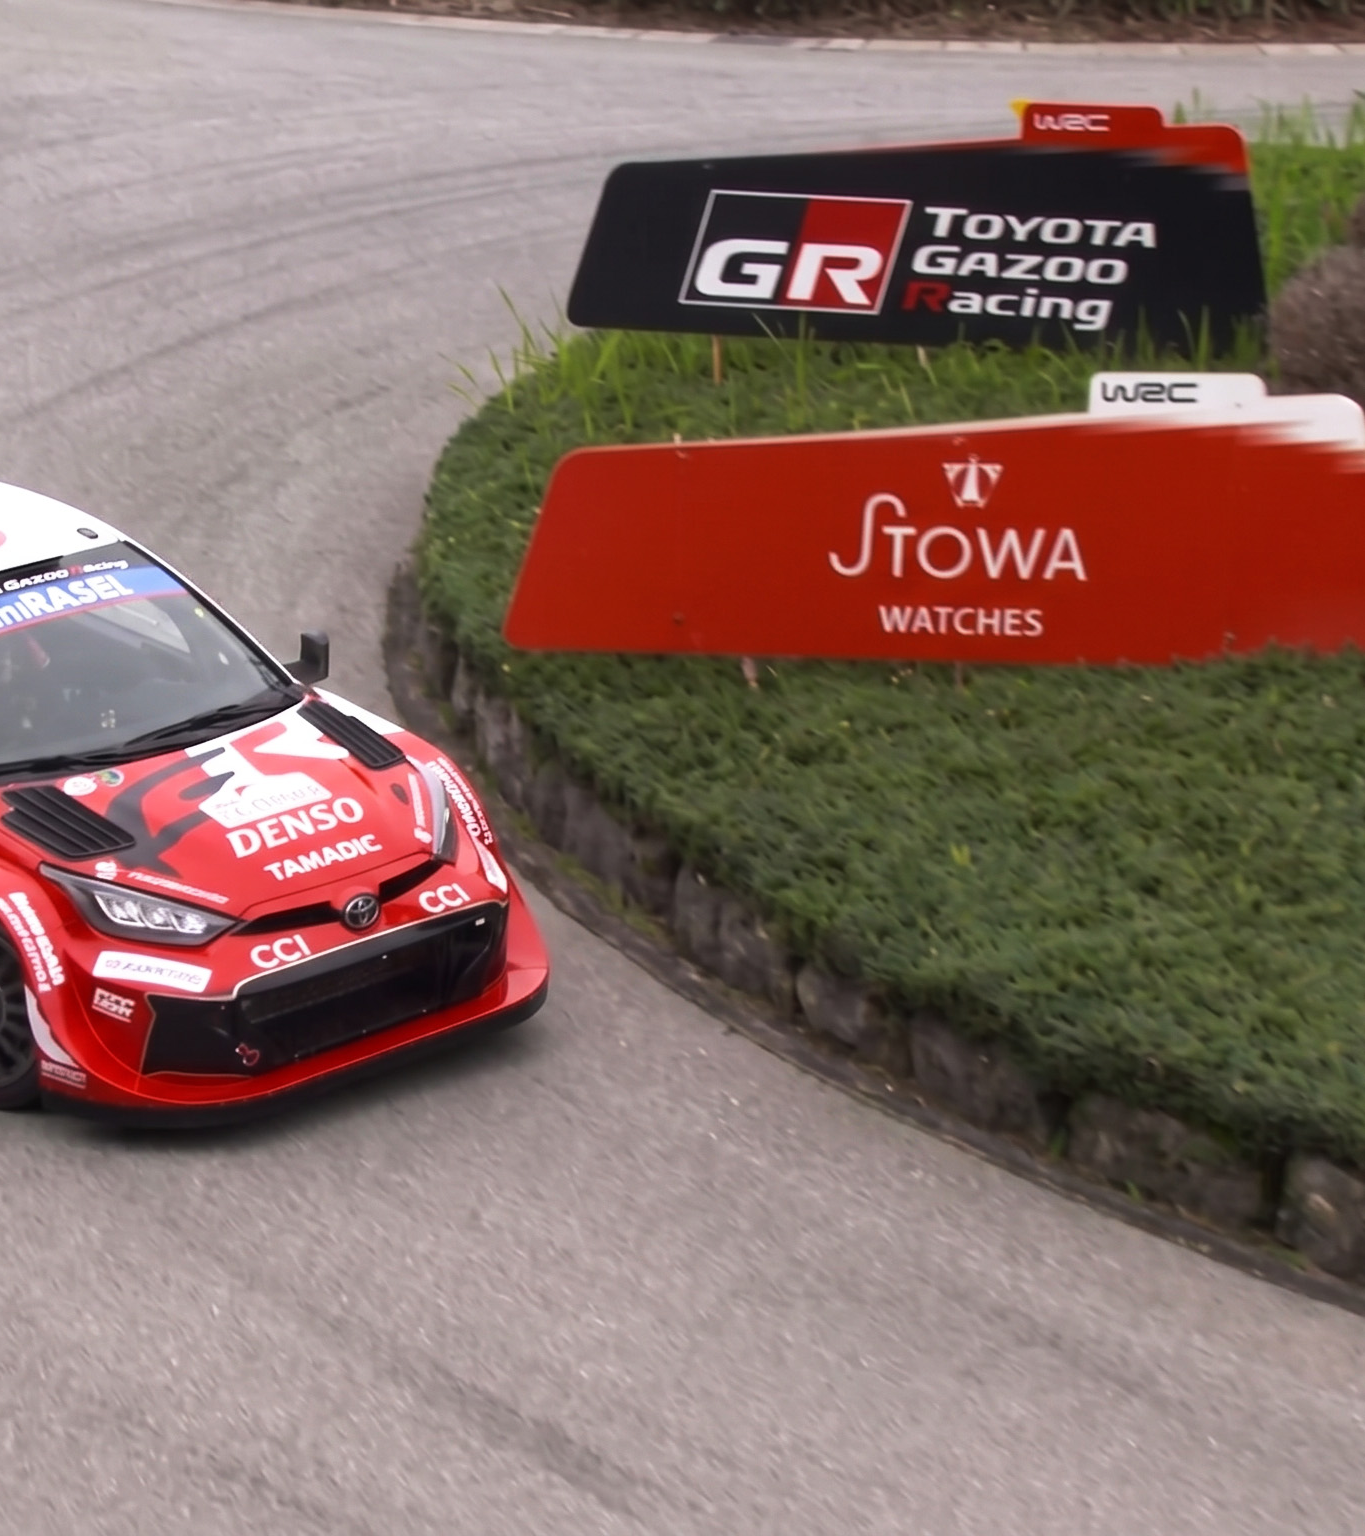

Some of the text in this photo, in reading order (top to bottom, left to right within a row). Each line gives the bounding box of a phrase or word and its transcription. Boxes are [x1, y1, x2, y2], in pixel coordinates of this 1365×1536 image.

[1033, 113, 1111, 132] WRC
[923, 205, 1158, 249] TOYOTA
[693, 237, 885, 307] GR
[910, 244, 1130, 286] GAZOO
[901, 280, 1114, 331] Racing
[1100, 381, 1200, 404] WRC
[827, 491, 1089, 582] STOWA
[878, 604, 1044, 638] WATCHES
[225, 796, 365, 859] DENSO
[262, 833, 384, 882] TAMADIC
[417, 882, 472, 915] CCI
[249, 933, 313, 969] CCI
